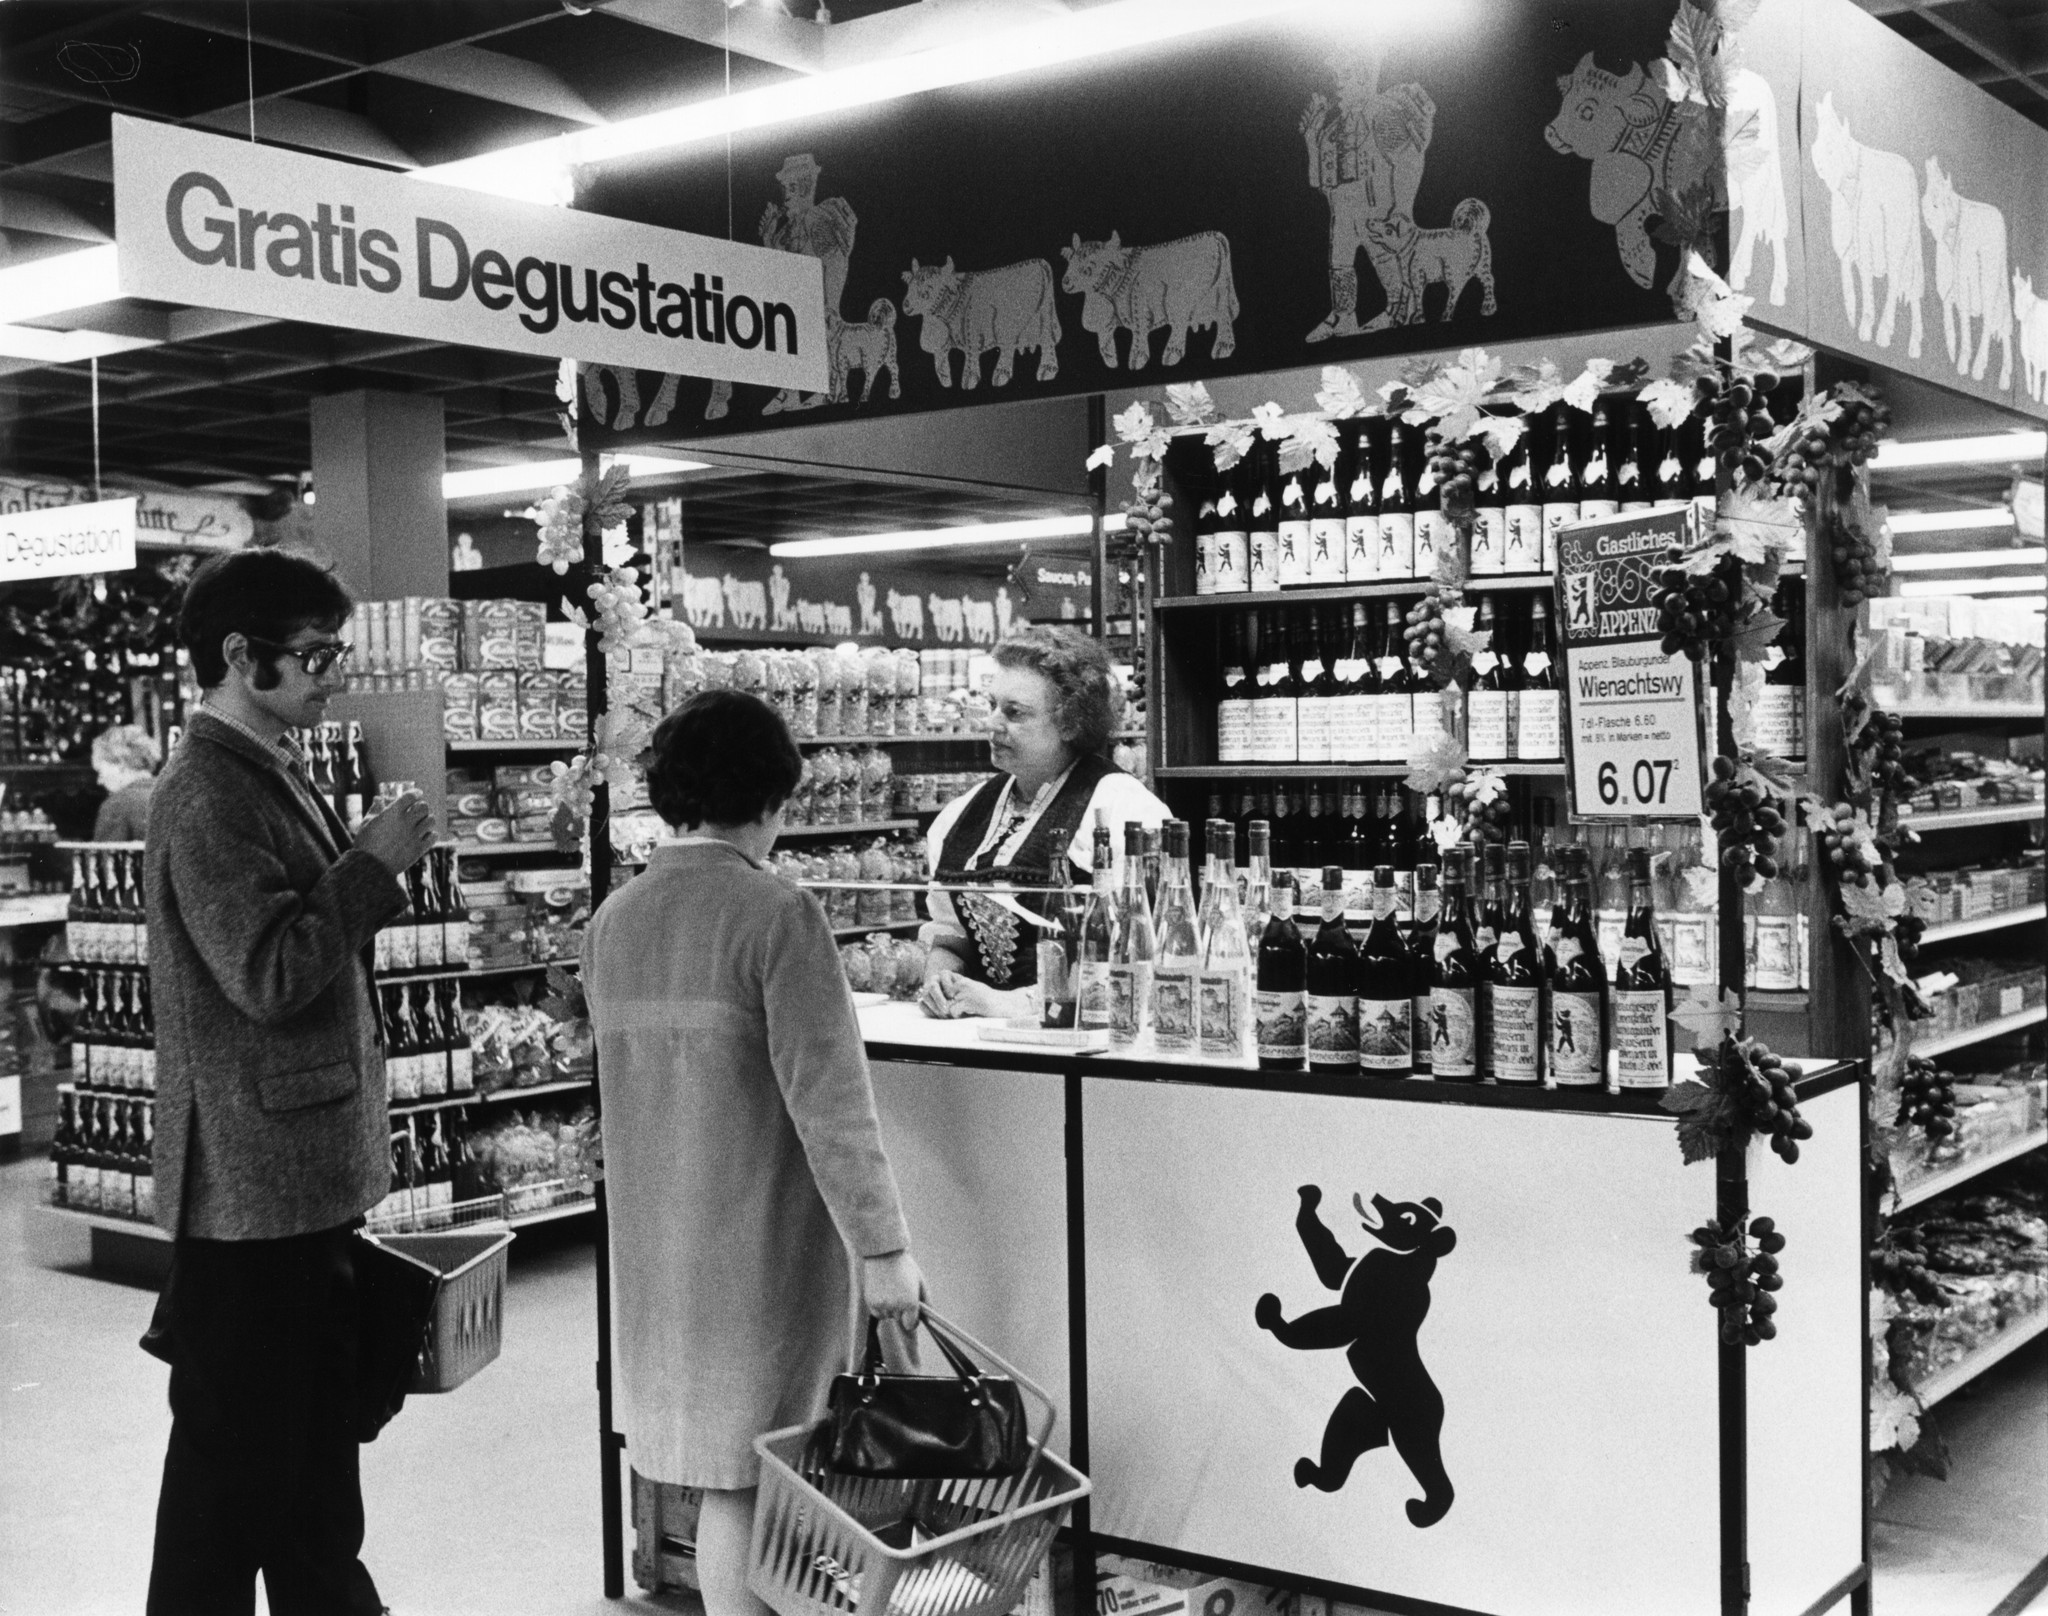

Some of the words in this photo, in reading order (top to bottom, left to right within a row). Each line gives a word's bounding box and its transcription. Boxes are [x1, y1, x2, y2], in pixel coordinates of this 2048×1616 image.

[165, 170, 403, 294] Gratis
[416, 216, 798, 356] Degustation
[6, 529, 122, 567] Degustation
[1596, 529, 1677, 556] Gastliches
[1598, 606, 1661, 638] APPENZ
[1578, 672, 1684, 699] Wienachtswy
